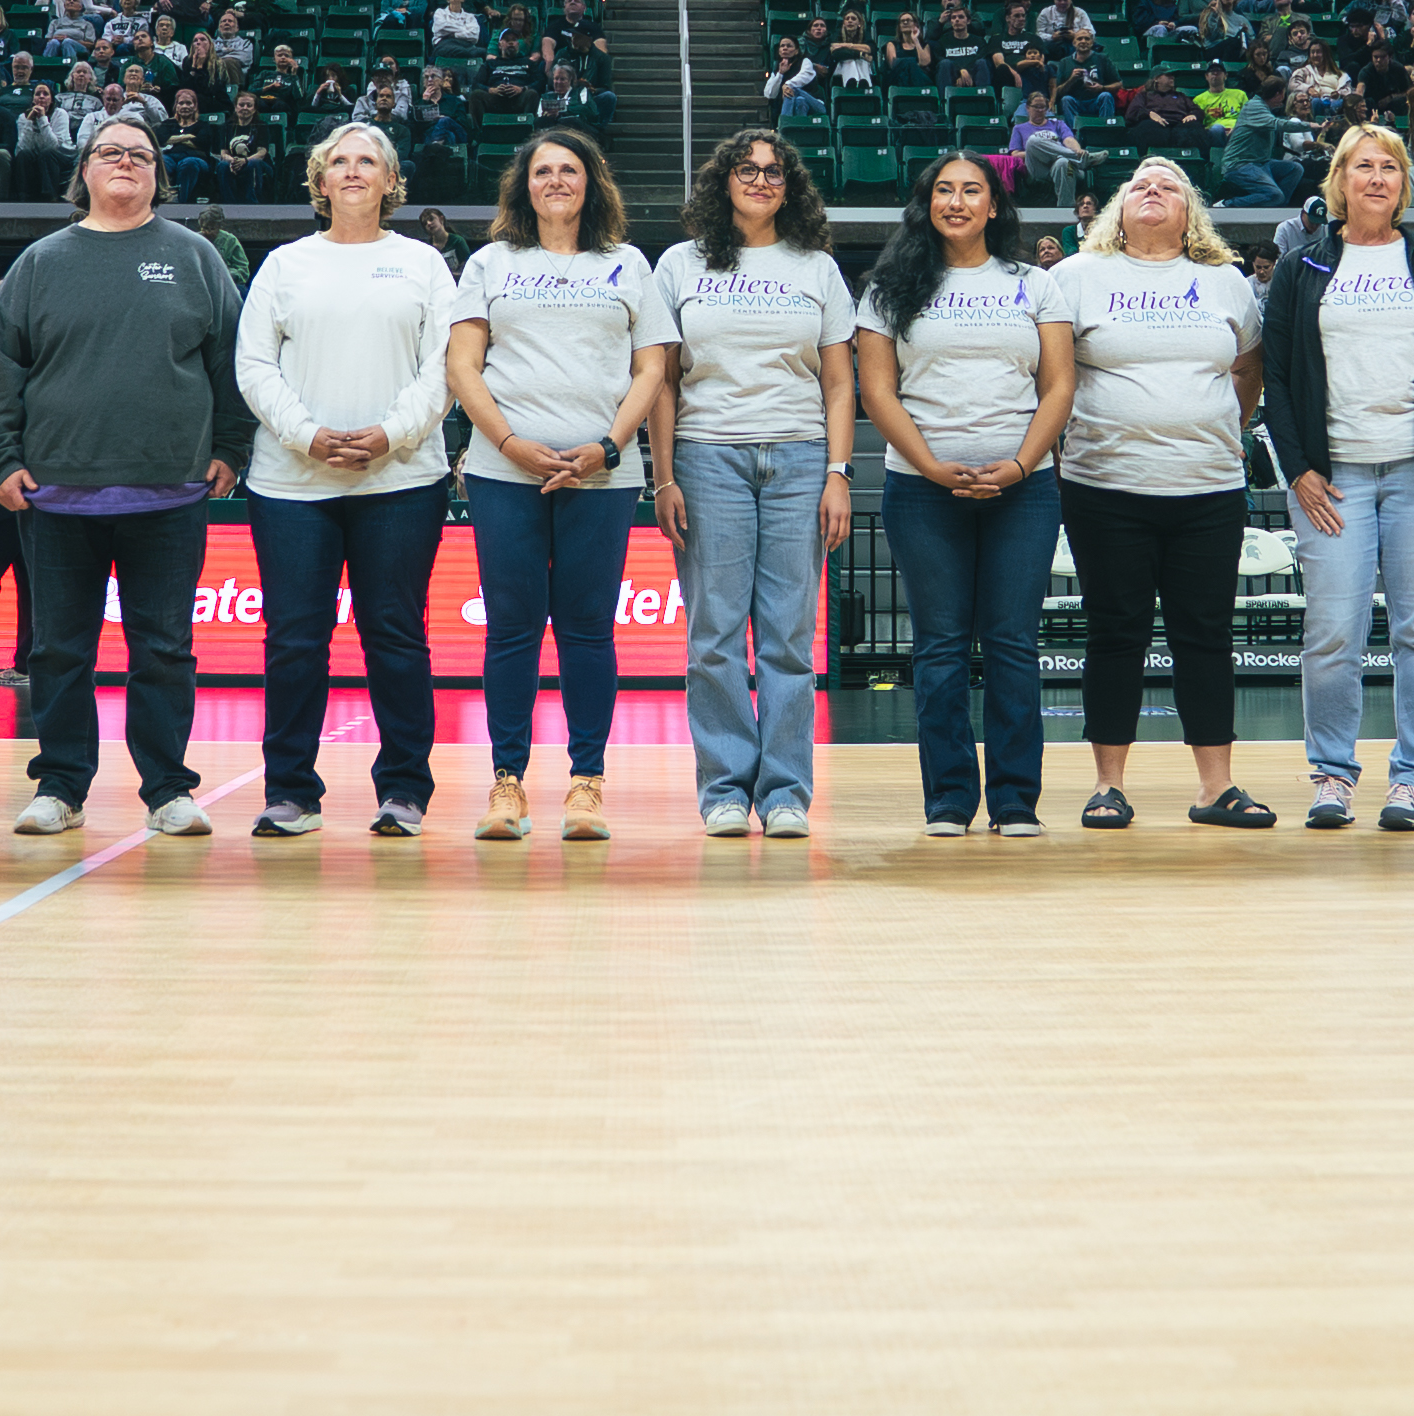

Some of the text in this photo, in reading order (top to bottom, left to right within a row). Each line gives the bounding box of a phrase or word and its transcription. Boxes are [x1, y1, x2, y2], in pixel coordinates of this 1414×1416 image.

[502, 272, 599, 290] Belive
[695, 273, 792, 294] Believe
[926, 292, 1010, 309] elieve
[1245, 600, 1290, 609] SPARTANS
